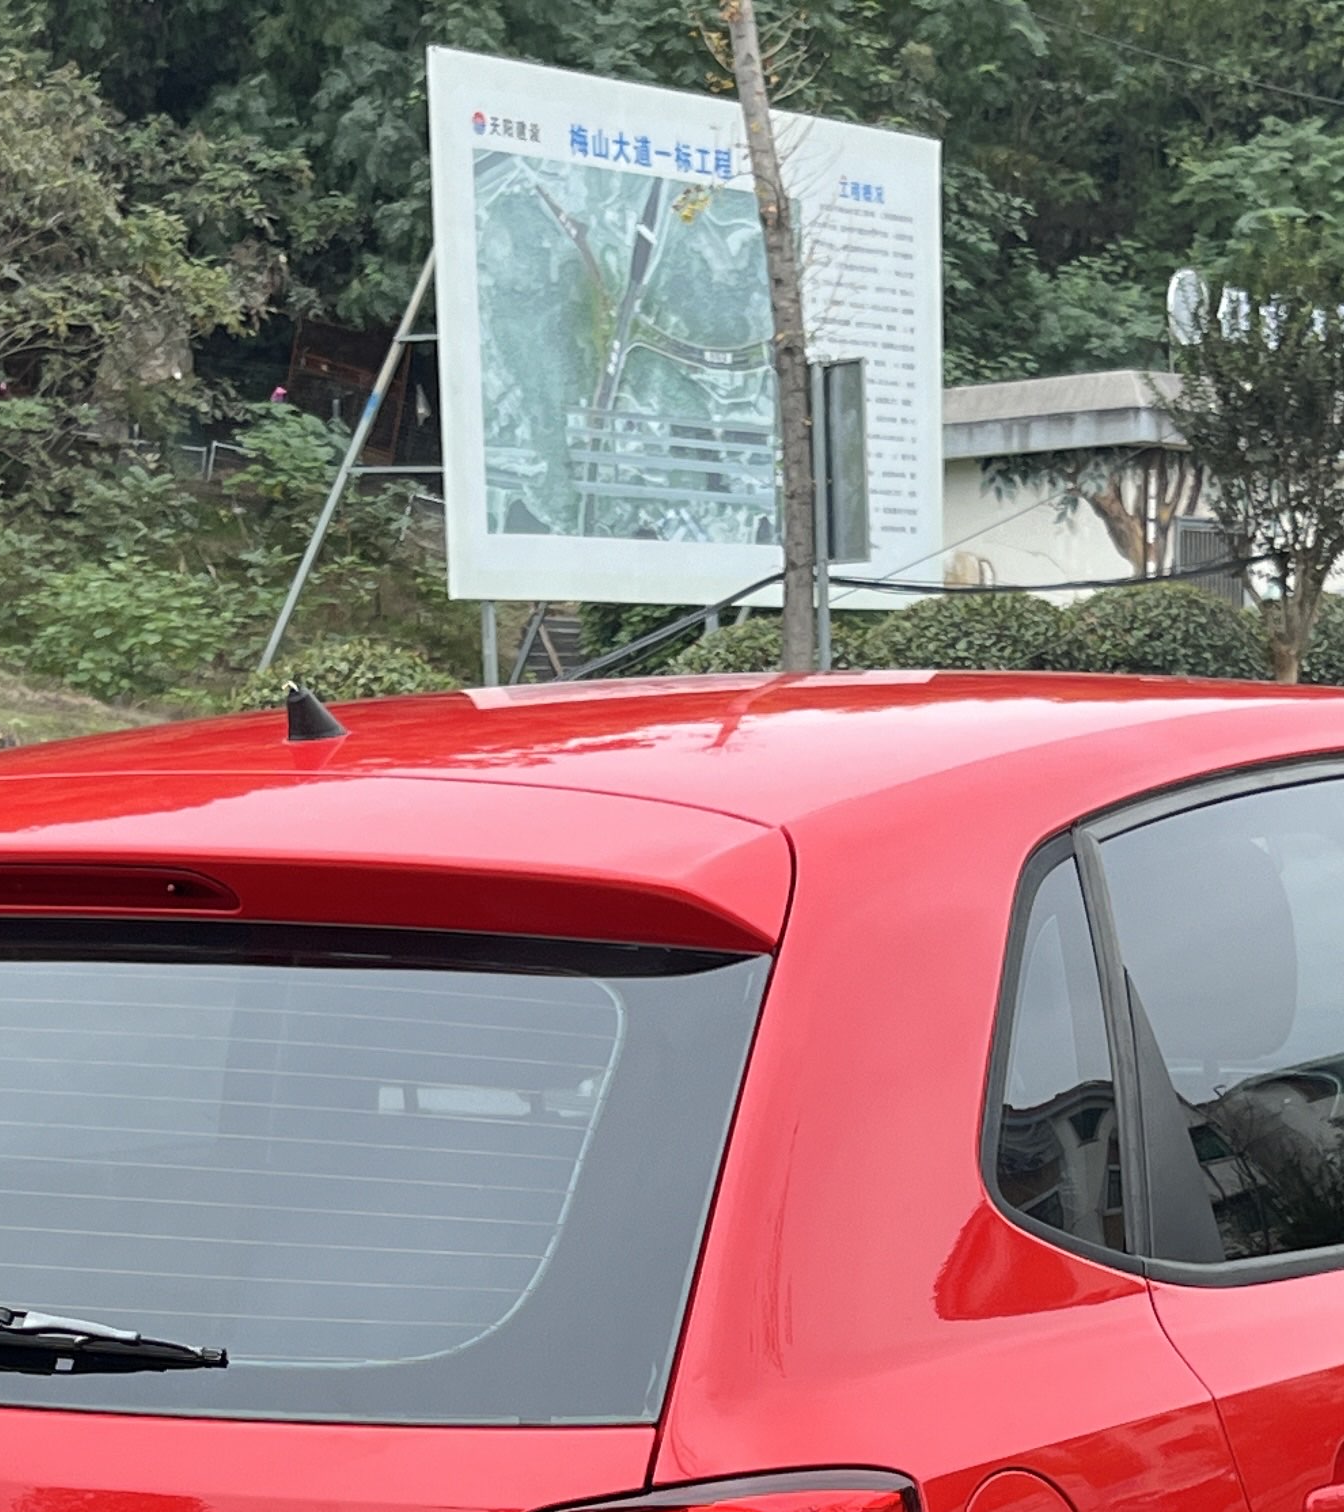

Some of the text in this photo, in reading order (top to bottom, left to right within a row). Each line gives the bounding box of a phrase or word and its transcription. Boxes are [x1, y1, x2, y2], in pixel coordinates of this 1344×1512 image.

[569, 124, 733, 180] 梅山大道一标工程
